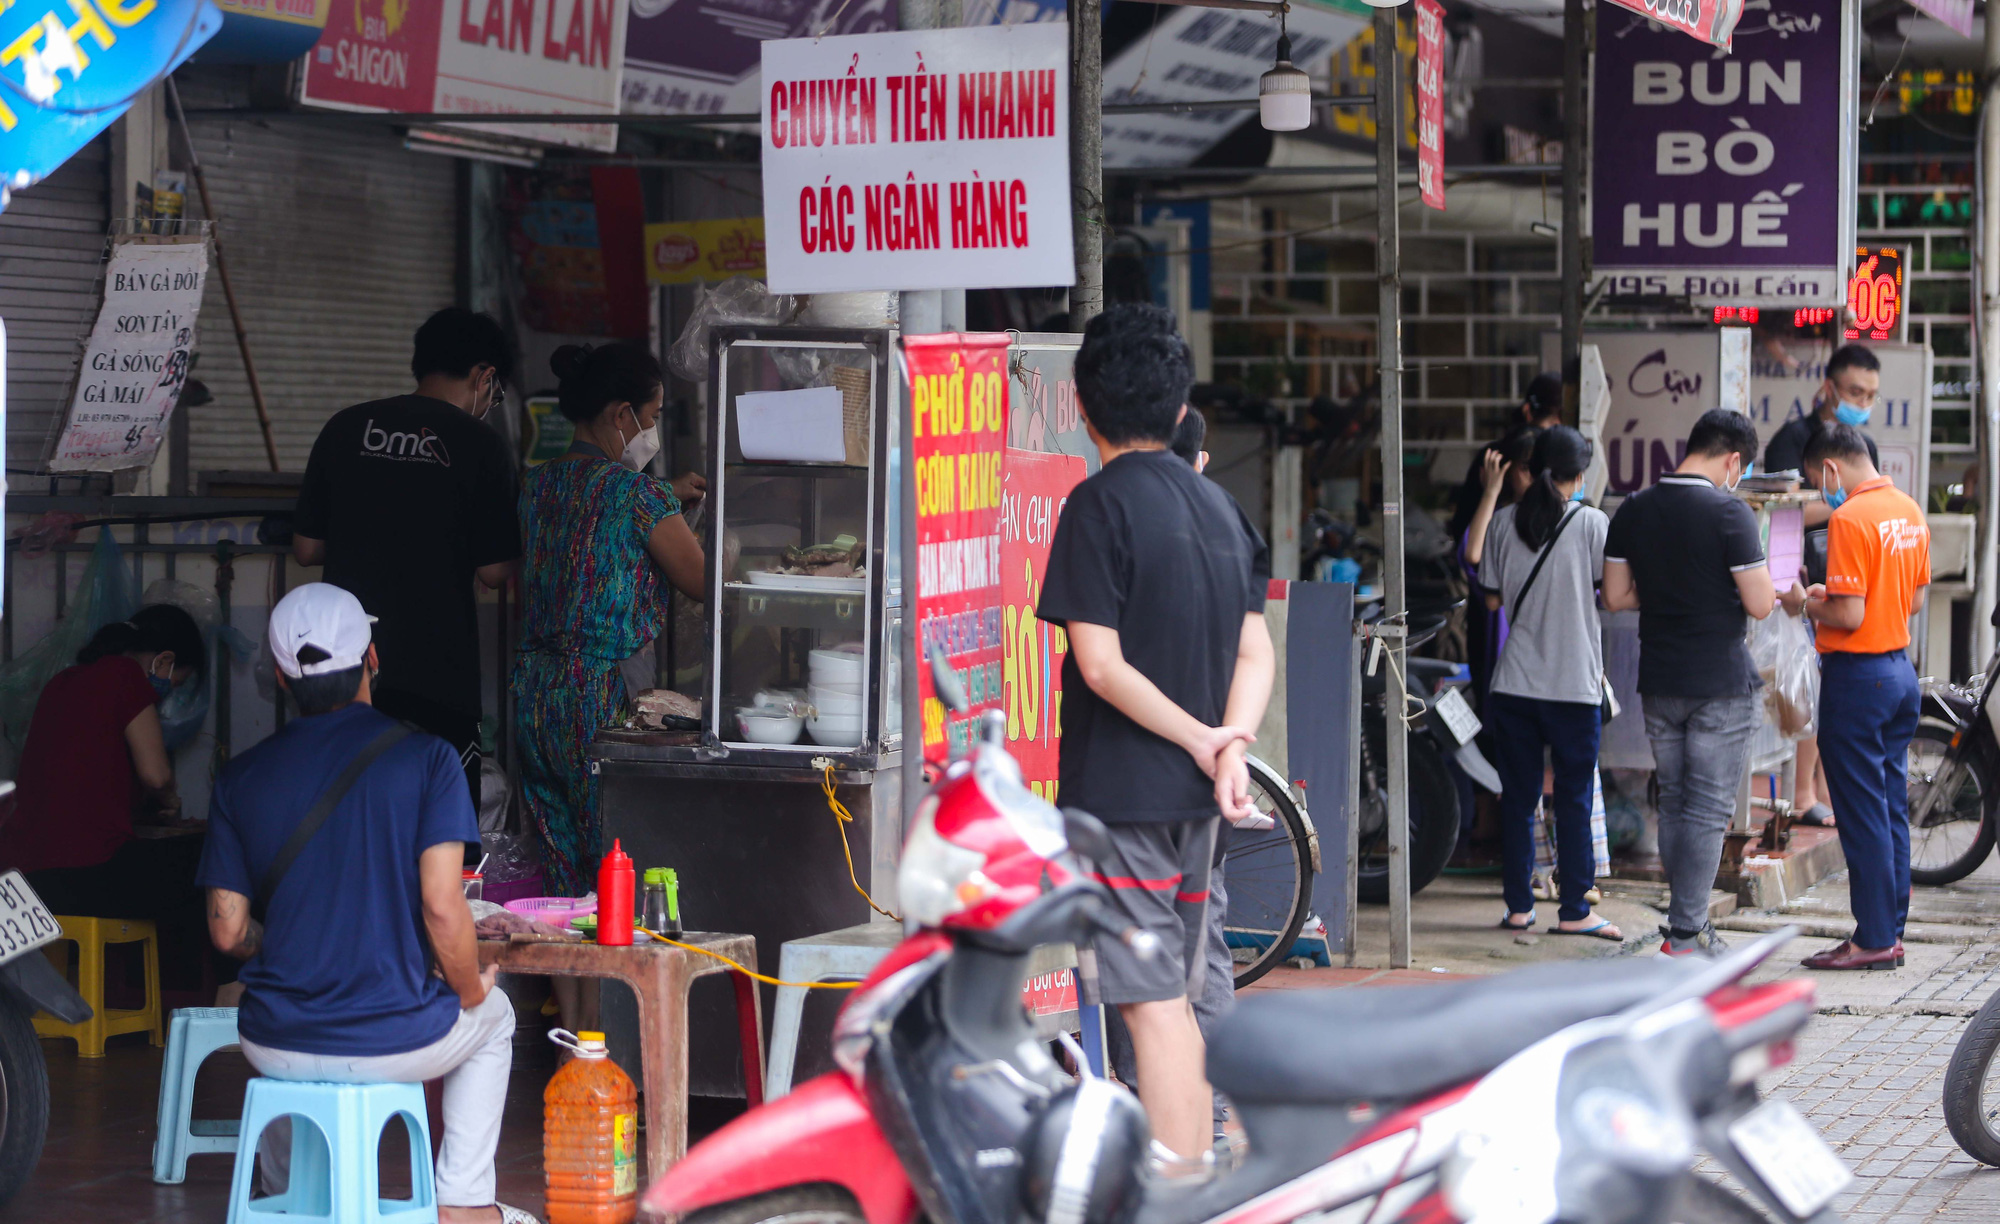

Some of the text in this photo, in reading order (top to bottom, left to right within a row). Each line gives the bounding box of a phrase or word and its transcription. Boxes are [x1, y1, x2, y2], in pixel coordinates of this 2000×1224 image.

[364, 17, 387, 42] BIA
[334, 39, 408, 89] SAIGON
[1632, 47, 1801, 105] BÚN
[770, 53, 877, 149] CHUYỂN
[886, 51, 947, 143] TIỀN
[958, 69, 1056, 139] NHANH
[1656, 116, 1775, 176] BÒ
[800, 175, 855, 254] CÁC
[865, 170, 940, 251] NGÂN
[950, 169, 1029, 248] HÀNG
[1623, 182, 1804, 248] HUẾ
[114, 268, 149, 292] BÁN
[150, 267, 170, 292] GÀ
[1683, 276, 1739, 298] Đội
[1755, 274, 1819, 297] Cấn
[114, 310, 183, 333] SƠN TÂY
[92, 349, 164, 373] GÀ SỐNG
[84, 380, 145, 404] GÀ MÁI
[914, 352, 965, 437] PHỞ
[970, 356, 1003, 433] BÒ
[363, 419, 438, 457] bmc
[1609, 418, 1690, 492] ÚN
[916, 449, 1002, 517] CƠM RANG
[1879, 518, 1907, 543] FPT
[1002, 557, 1041, 742] HỞ
